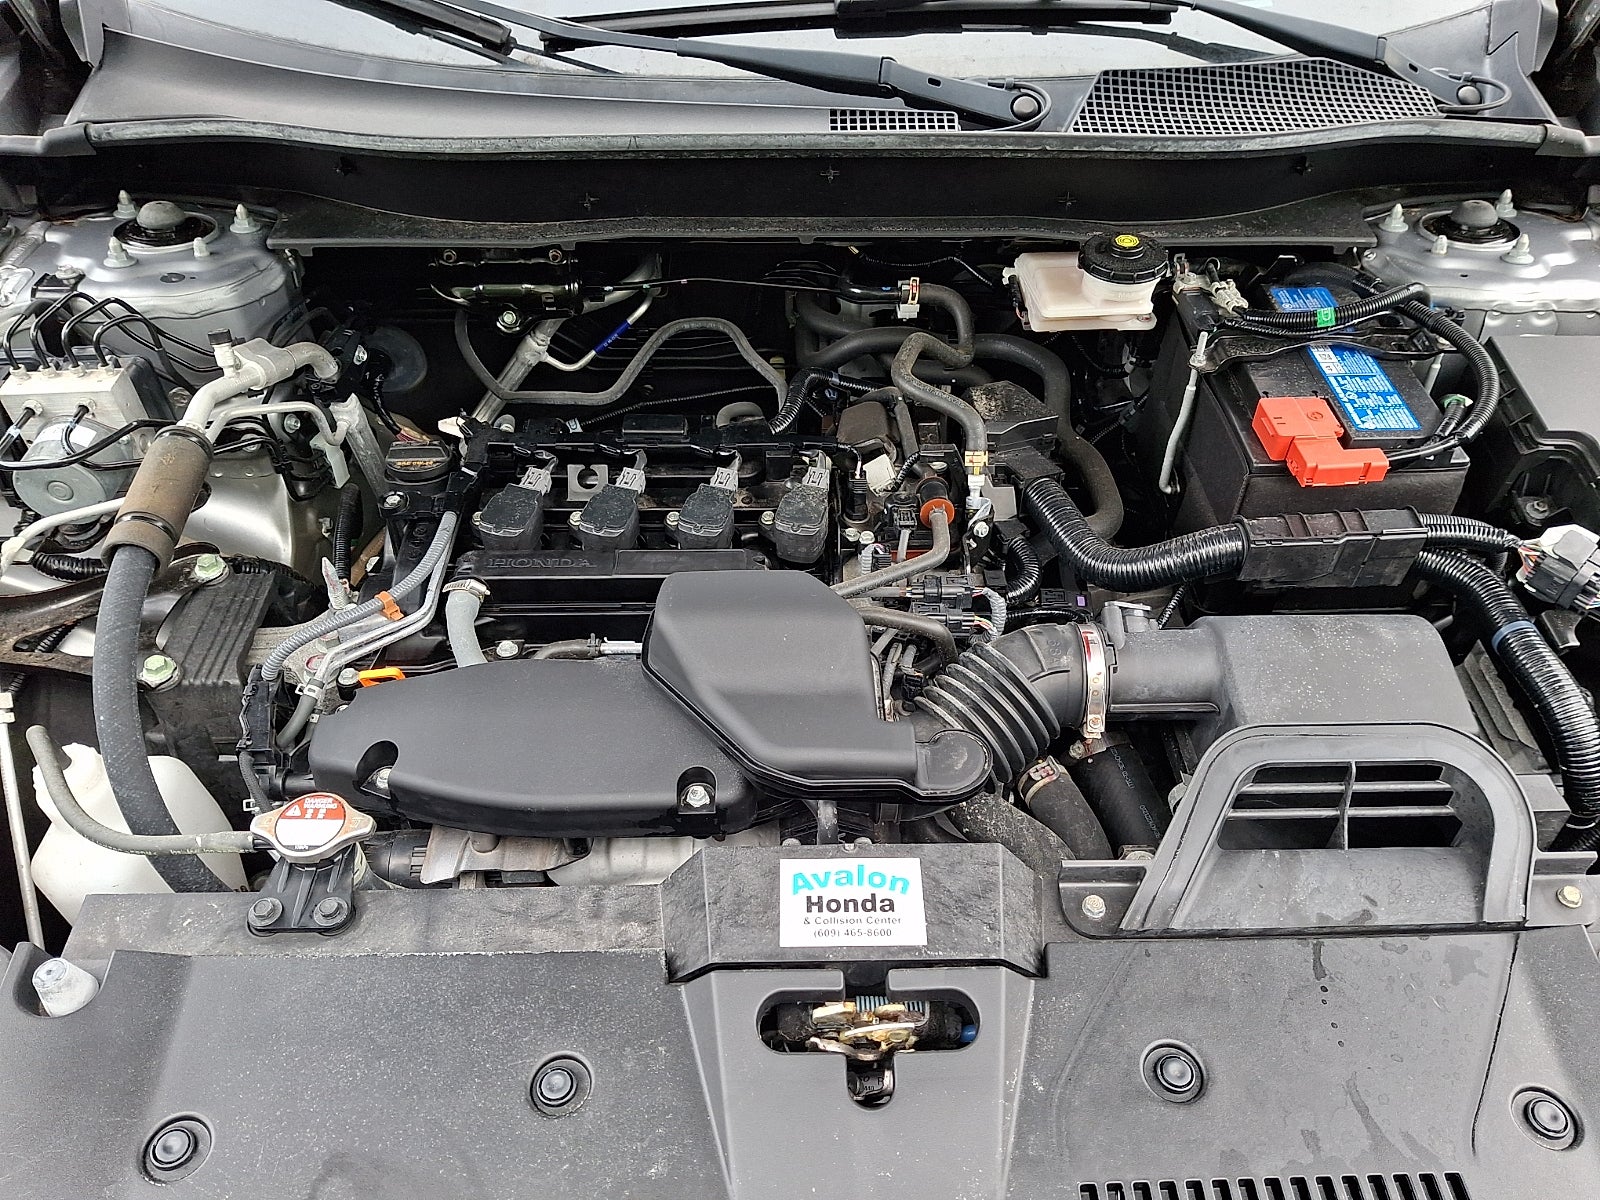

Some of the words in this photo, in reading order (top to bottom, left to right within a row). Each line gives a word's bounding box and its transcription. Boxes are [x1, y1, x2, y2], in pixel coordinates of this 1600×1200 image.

[487, 558, 597, 568] HONDA
[792, 864, 910, 895] Avalon
[806, 893, 895, 913] Honda
[803, 917, 811, 925] &
[814, 916, 863, 925] Collision
[866, 916, 902, 925] Center
[813, 928, 840, 938] (609)
[844, 928, 892, 937] 465-8600
